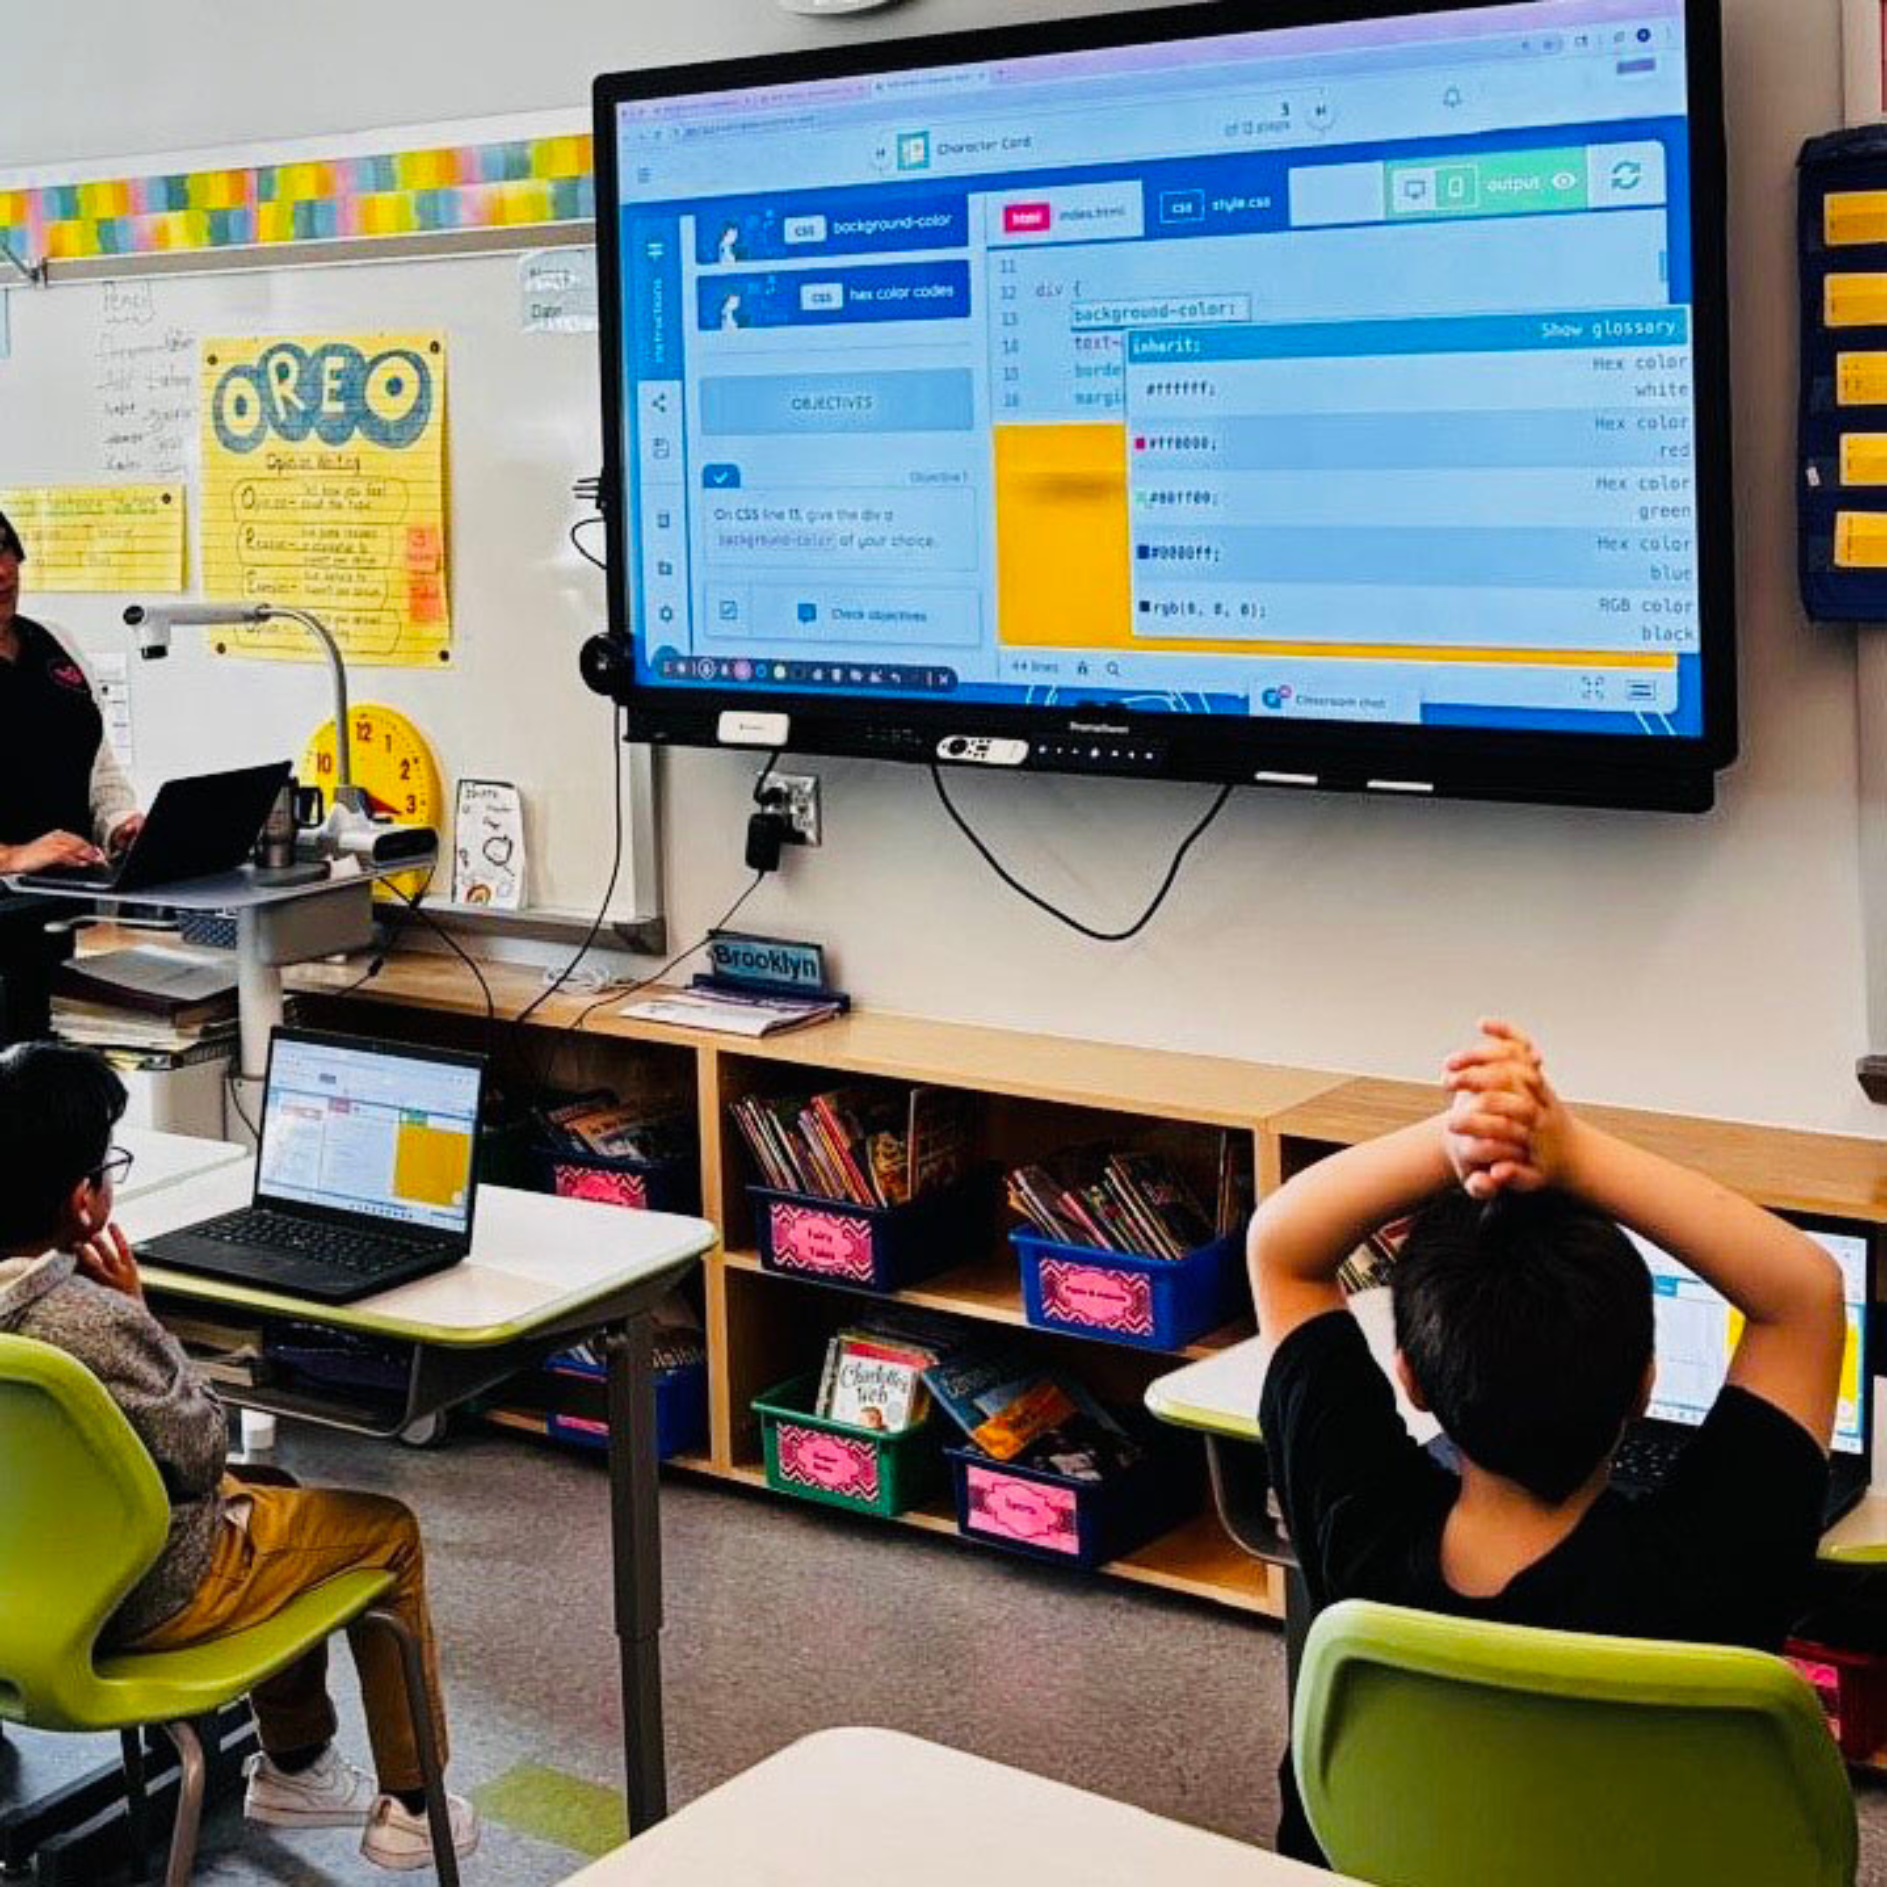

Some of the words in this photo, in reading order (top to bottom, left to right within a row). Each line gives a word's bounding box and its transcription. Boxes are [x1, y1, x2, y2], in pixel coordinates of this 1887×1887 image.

[937, 139, 998, 155] Character
[1002, 135, 1032, 150] Card
[1487, 175, 1540, 193] output
[1211, 194, 1271, 213] style.css
[833, 213, 952, 235] background-color
[850, 287, 873, 301] hex
[876, 285, 909, 301] color
[913, 283, 954, 299] codes
[1035, 282, 1063, 297] div
[1541, 321, 1584, 339] Show
[1592, 319, 1676, 339] glossary
[1592, 355, 1624, 371] Hex
[1635, 354, 1689, 371] color
[218, 347, 427, 444] OREO
[1634, 381, 1689, 397] white
[791, 396, 873, 411] OBJECTIVES
[1594, 415, 1625, 431] Hex
[1636, 414, 1690, 431] color
[1660, 442, 1691, 458] red
[1595, 474, 1627, 491] Hex
[1638, 473, 1690, 492] color
[714, 508, 734, 521] On
[736, 508, 759, 521] CSS
[763, 508, 785, 521] line
[806, 508, 833, 523] give
[837, 507, 858, 521] the
[860, 507, 881, 521] div
[1639, 504, 1691, 520] green
[718, 534, 833, 550] background-color
[838, 534, 854, 548] of
[857, 536, 888, 551] your
[1596, 535, 1629, 551] Hex
[1639, 535, 1692, 551] color
[1650, 564, 1692, 581] blue
[1599, 598, 1631, 613] RGB
[1641, 598, 1693, 614] color
[832, 607, 864, 620] Check
[868, 608, 927, 623] objectives
[1642, 625, 1694, 641] black
[1031, 660, 1058, 673] lines
[356, 720, 372, 742] 12
[385, 734, 392, 753] 1
[316, 753, 332, 773] 10
[400, 758, 410, 781] 2
[406, 794, 416, 814] 3
[714, 944, 818, 979] Brooklyn
